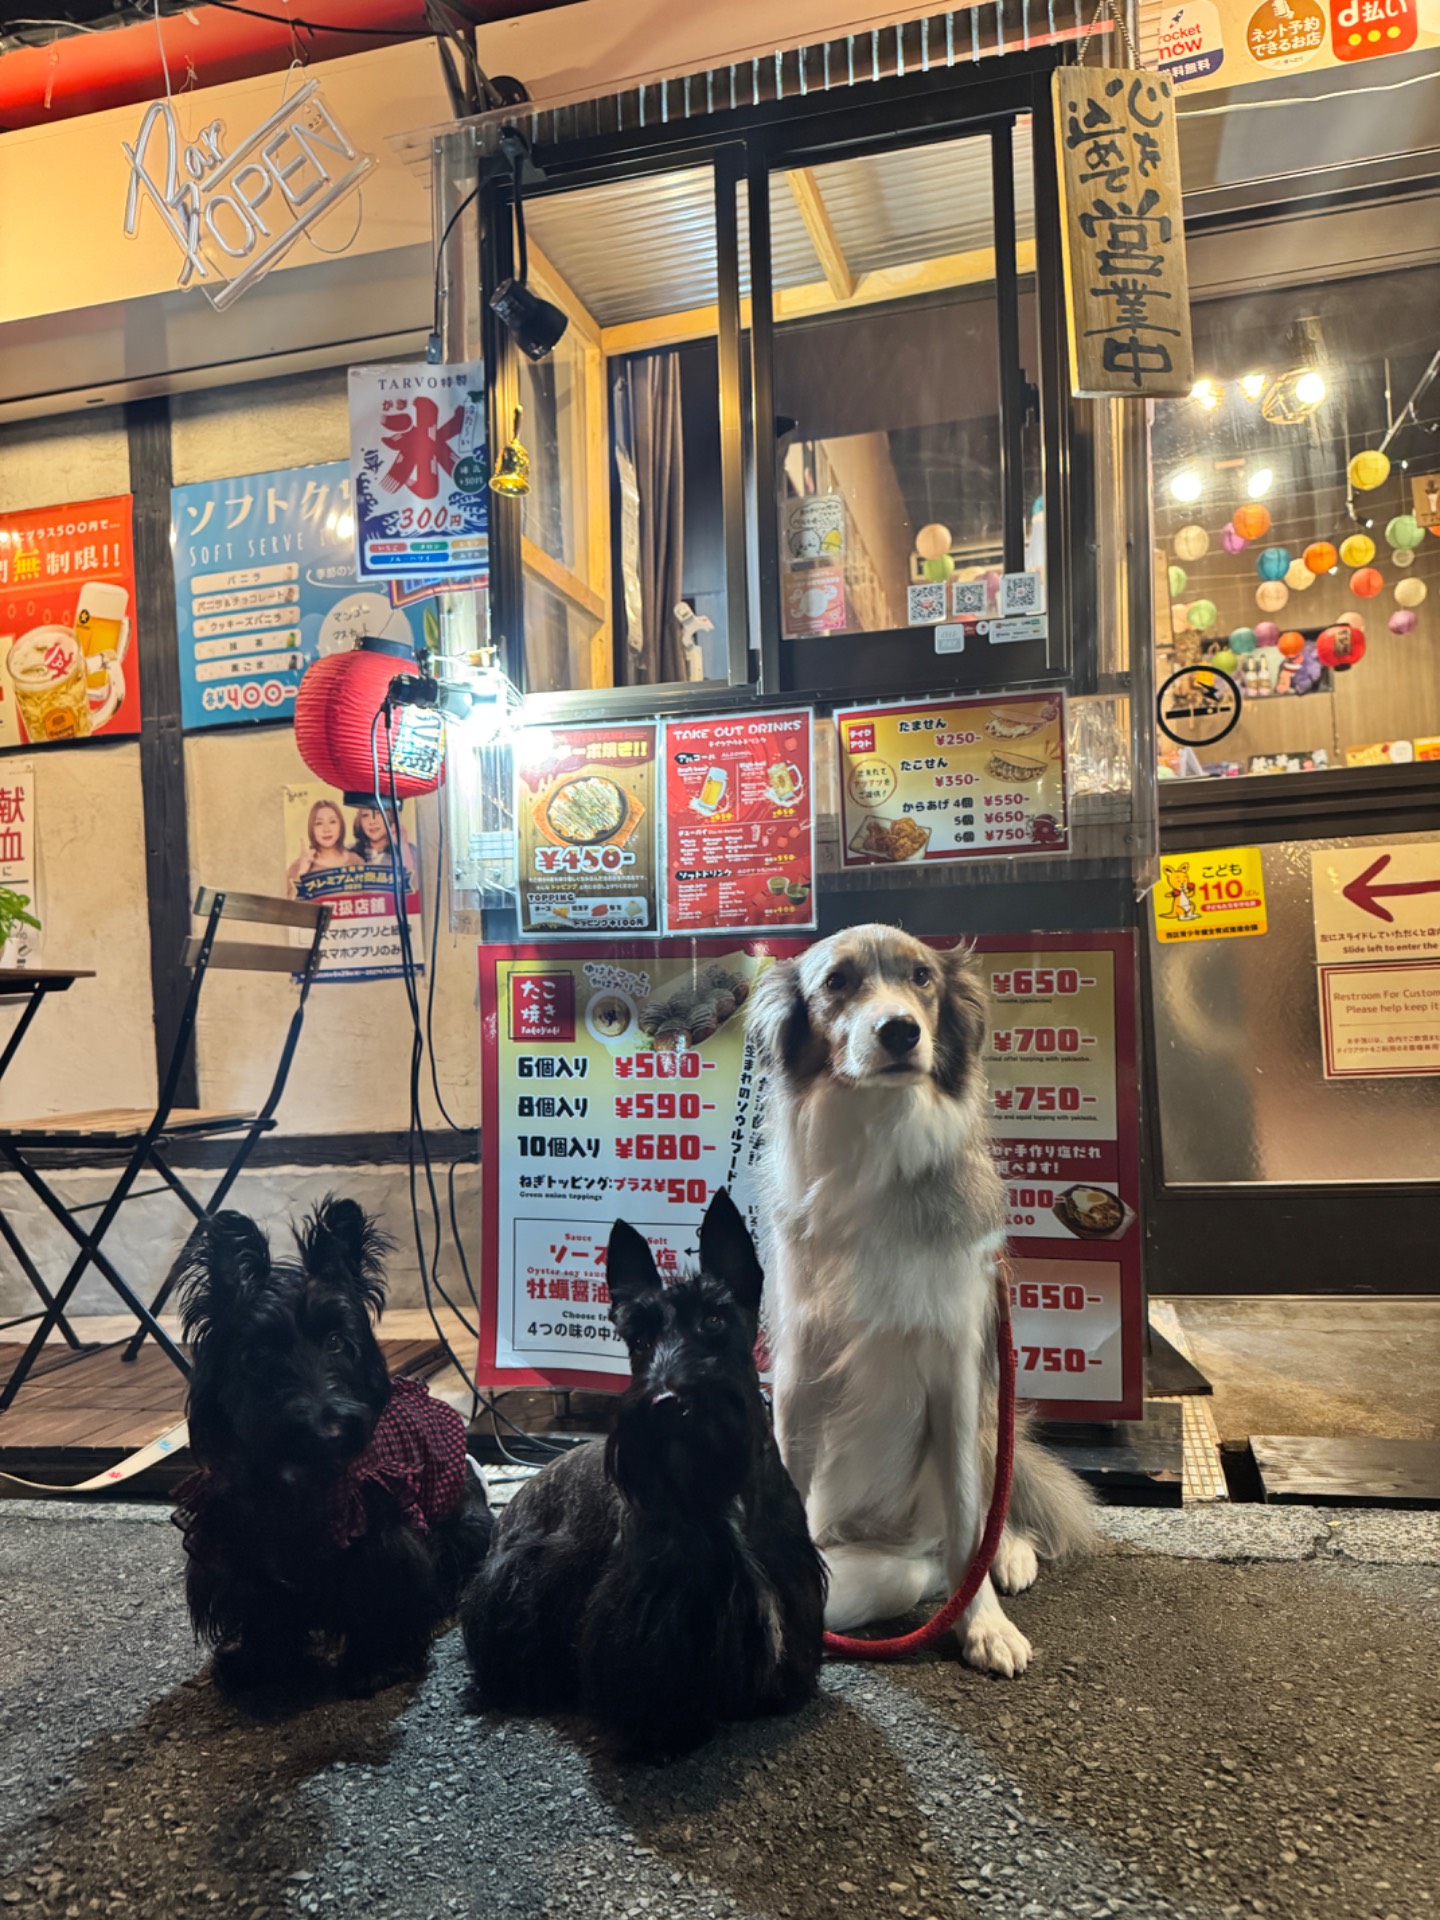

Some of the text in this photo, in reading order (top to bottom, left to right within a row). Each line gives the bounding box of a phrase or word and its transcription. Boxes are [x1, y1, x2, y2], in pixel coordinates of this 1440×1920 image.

[1251, 17, 1321, 43] ネット予約
[1252, 31, 1321, 57] できるお店
[205, 98, 355, 258] OPEN
[1078, 188, 1182, 387] 営業中
[380, 396, 465, 500] 氷
[399, 506, 462, 530] 300円
[190, 544, 233, 567] SOFT
[248, 532, 304, 558] SERVE
[227, 573, 261, 586] バニラ
[673, 720, 802, 740] TAKE OUT DRINKS
[849, 730, 871, 739] テイク
[898, 718, 947, 733] たません
[850, 740, 872, 749] アウト
[936, 732, 981, 747] ¥250-
[900, 757, 948, 772] たこせん
[935, 774, 981, 787] ¥350-
[902, 793, 1030, 813] からあげ 4個 ¥550-
[954, 811, 1030, 826] 5個 ¥650-
[954, 828, 1030, 843] 6個 ¥750-
[536, 848, 634, 872] ¥450-
[1202, 864, 1242, 878] こども
[528, 894, 574, 902] TOPPING
[1343, 946, 1365, 954] Slide
[1367, 944, 1383, 953] left
[1385, 944, 1395, 952] to
[1397, 943, 1421, 951] enter
[521, 980, 557, 999] たこ
[992, 970, 1096, 994] ¥650-
[1334, 992, 1381, 1001] Restroom
[1384, 990, 1400, 999] For
[521, 1004, 557, 1024] 焼き
[1346, 1002, 1440, 1014] Please help keep it
[993, 1029, 1096, 1052] ¥700-
[518, 1057, 587, 1078] 6個入り
[518, 1094, 716, 1118] 8個入り ¥590-
[995, 1087, 1096, 1110] ¥750-
[518, 1135, 716, 1159] 10個入り ¥680-
[564, 1233, 592, 1242] Sauce
[656, 1249, 678, 1270] 塩
[562, 1310, 595, 1320] Choose
[1015, 1346, 1103, 1372] 750-
